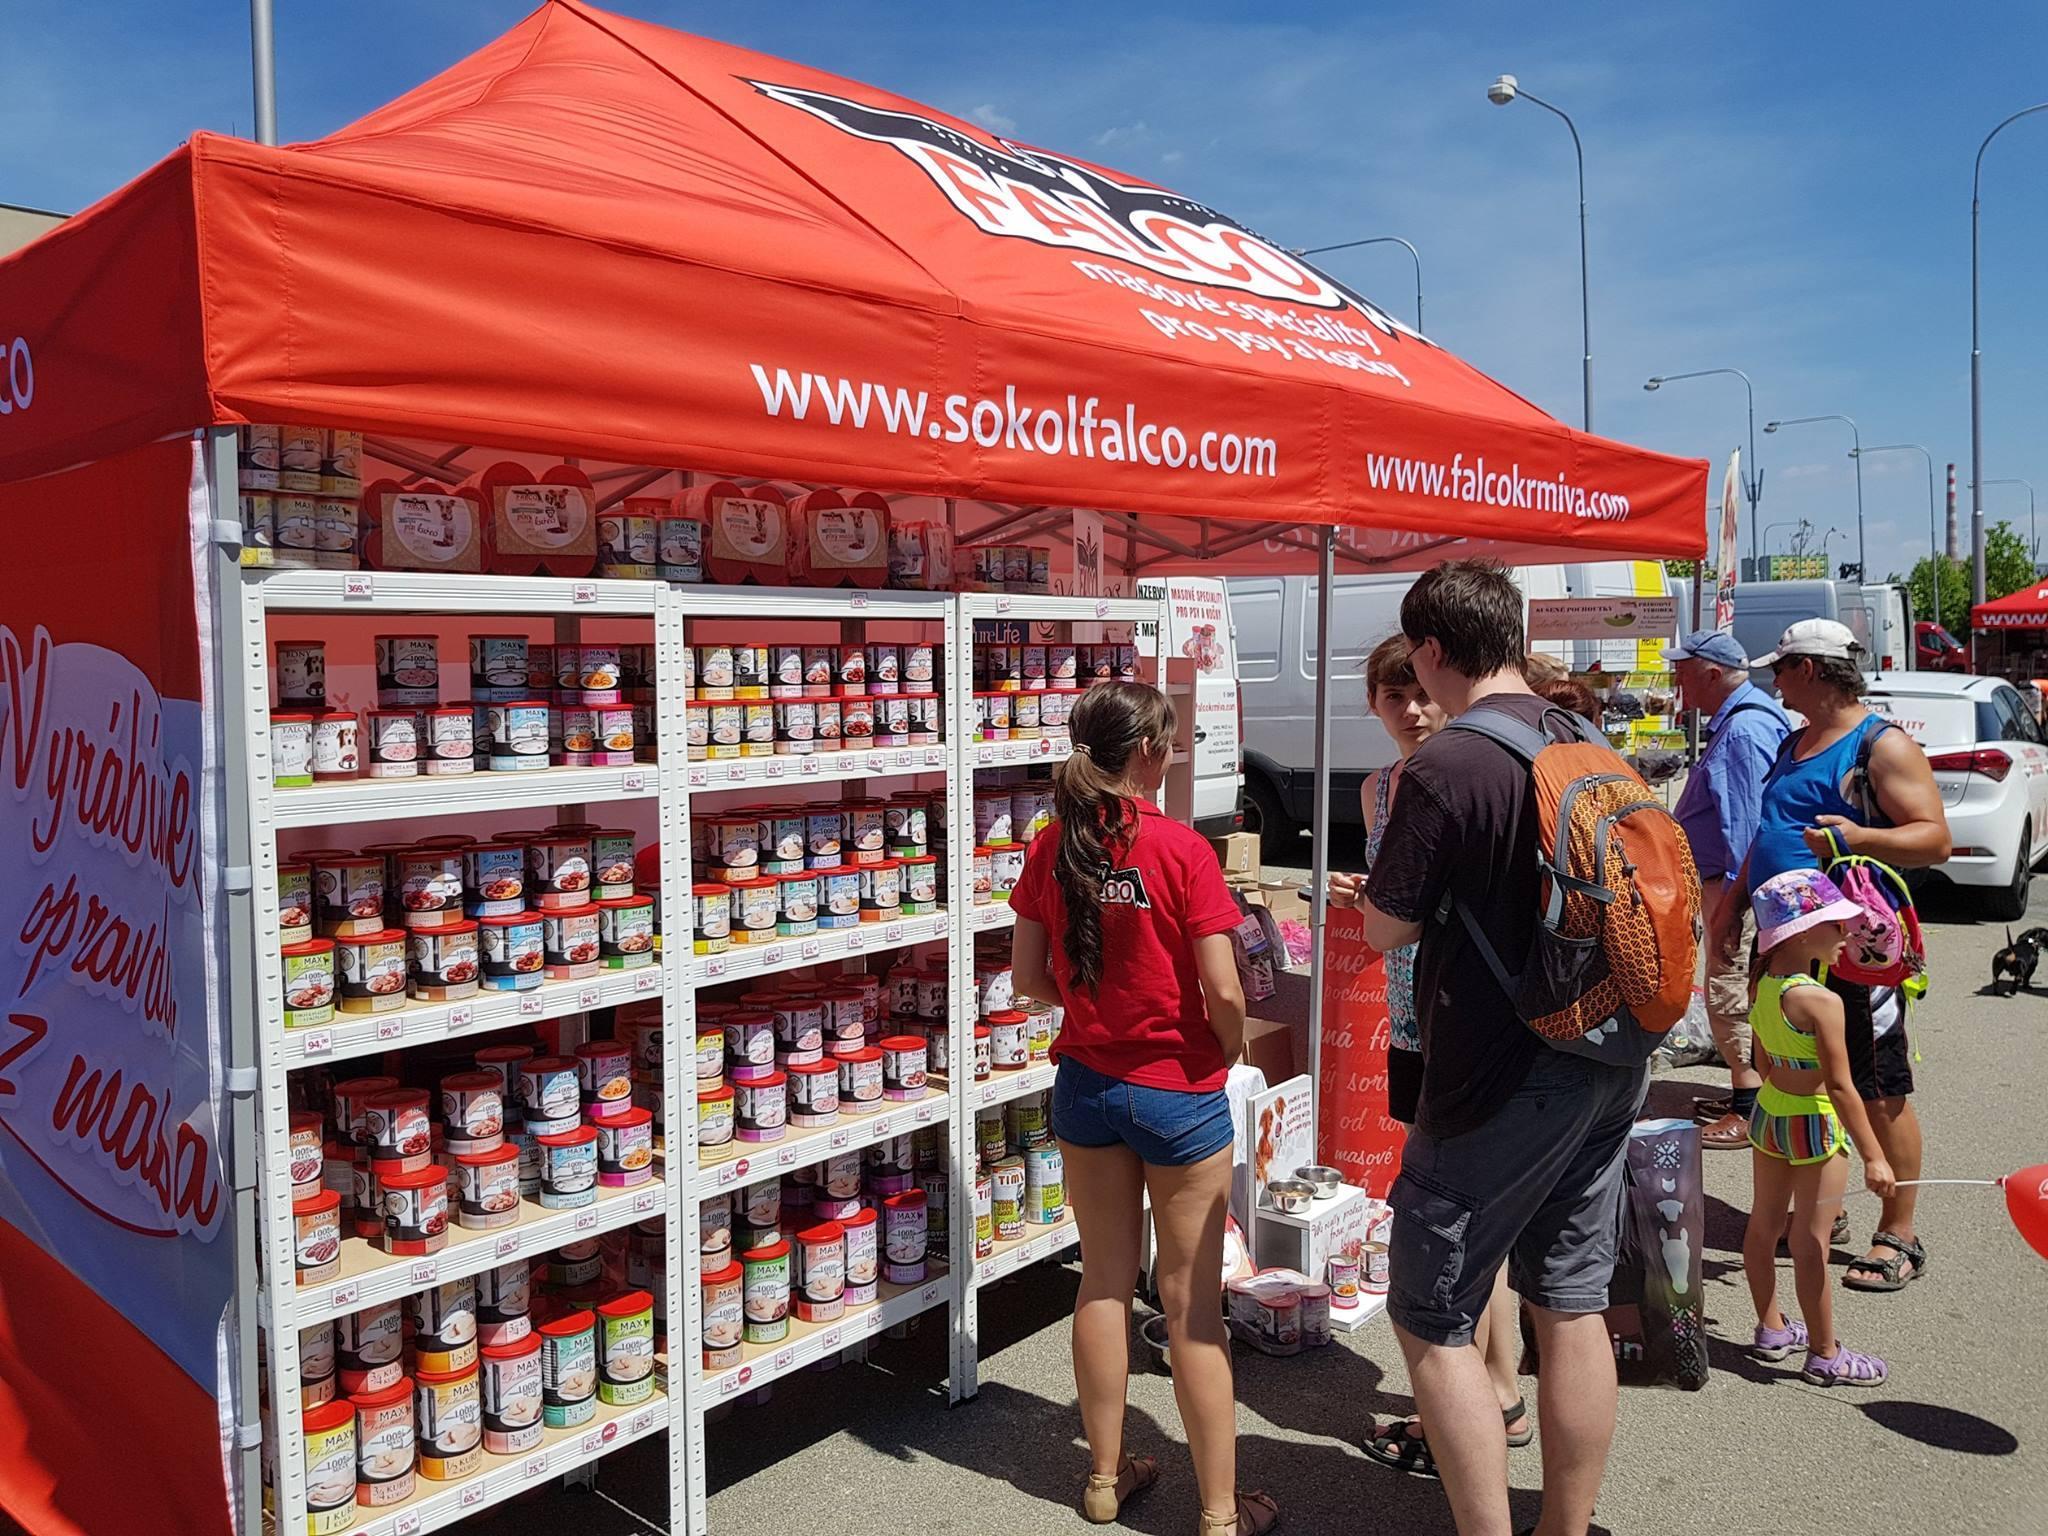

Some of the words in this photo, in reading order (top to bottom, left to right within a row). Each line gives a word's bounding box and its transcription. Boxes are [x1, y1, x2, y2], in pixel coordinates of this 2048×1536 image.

[917, 145, 1323, 297] FALCO
[1071, 258, 1231, 317] masové
[1226, 300, 1382, 356] speciality
[1139, 307, 1219, 341] pro
[1214, 326, 1293, 361] psy
[749, 363, 1278, 477] www.sokolfalco.com
[1366, 453, 1630, 522] www.falcokrmiva.com
[321, 505, 340, 513] MAX
[1136, 583, 1166, 600] NZERVY
[410, 641, 427, 649] MAX
[500, 641, 517, 649] MAX
[525, 709, 541, 717] MAX
[494, 853, 512, 862] MAX
[632, 909, 647, 917] MAX
[578, 917, 594, 925] MAX
[524, 926, 540, 934] MAX
[455, 935, 471, 944] MAX
[383, 944, 399, 952] MAX
[303, 956, 322, 965] MAX
[611, 1057, 627, 1065] MAX
[53, 1054, 219, 1228] masa
[566, 1146, 585, 1155] MAX
[496, 1164, 512, 1173] MAX
[314, 1213, 331, 1222] MAX
[896, 1212, 917, 1220] MAX
[312, 1228, 333, 1239] 100%
[819, 1244, 838, 1255] MAX
[757, 1265, 778, 1274] MAX
[718, 1287, 739, 1299] MAX
[620, 1319, 643, 1331] MAX
[574, 1335, 593, 1349] MAX
[621, 1340, 641, 1351] 100%
[517, 1359, 539, 1373] MAX
[453, 1380, 475, 1398] MAX
[380, 1405, 405, 1421] MAX
[455, 1404, 476, 1419] 100%
[325, 1430, 352, 1448] MAX
[381, 1430, 406, 1444] 100%
[327, 1455, 350, 1470] 100%
